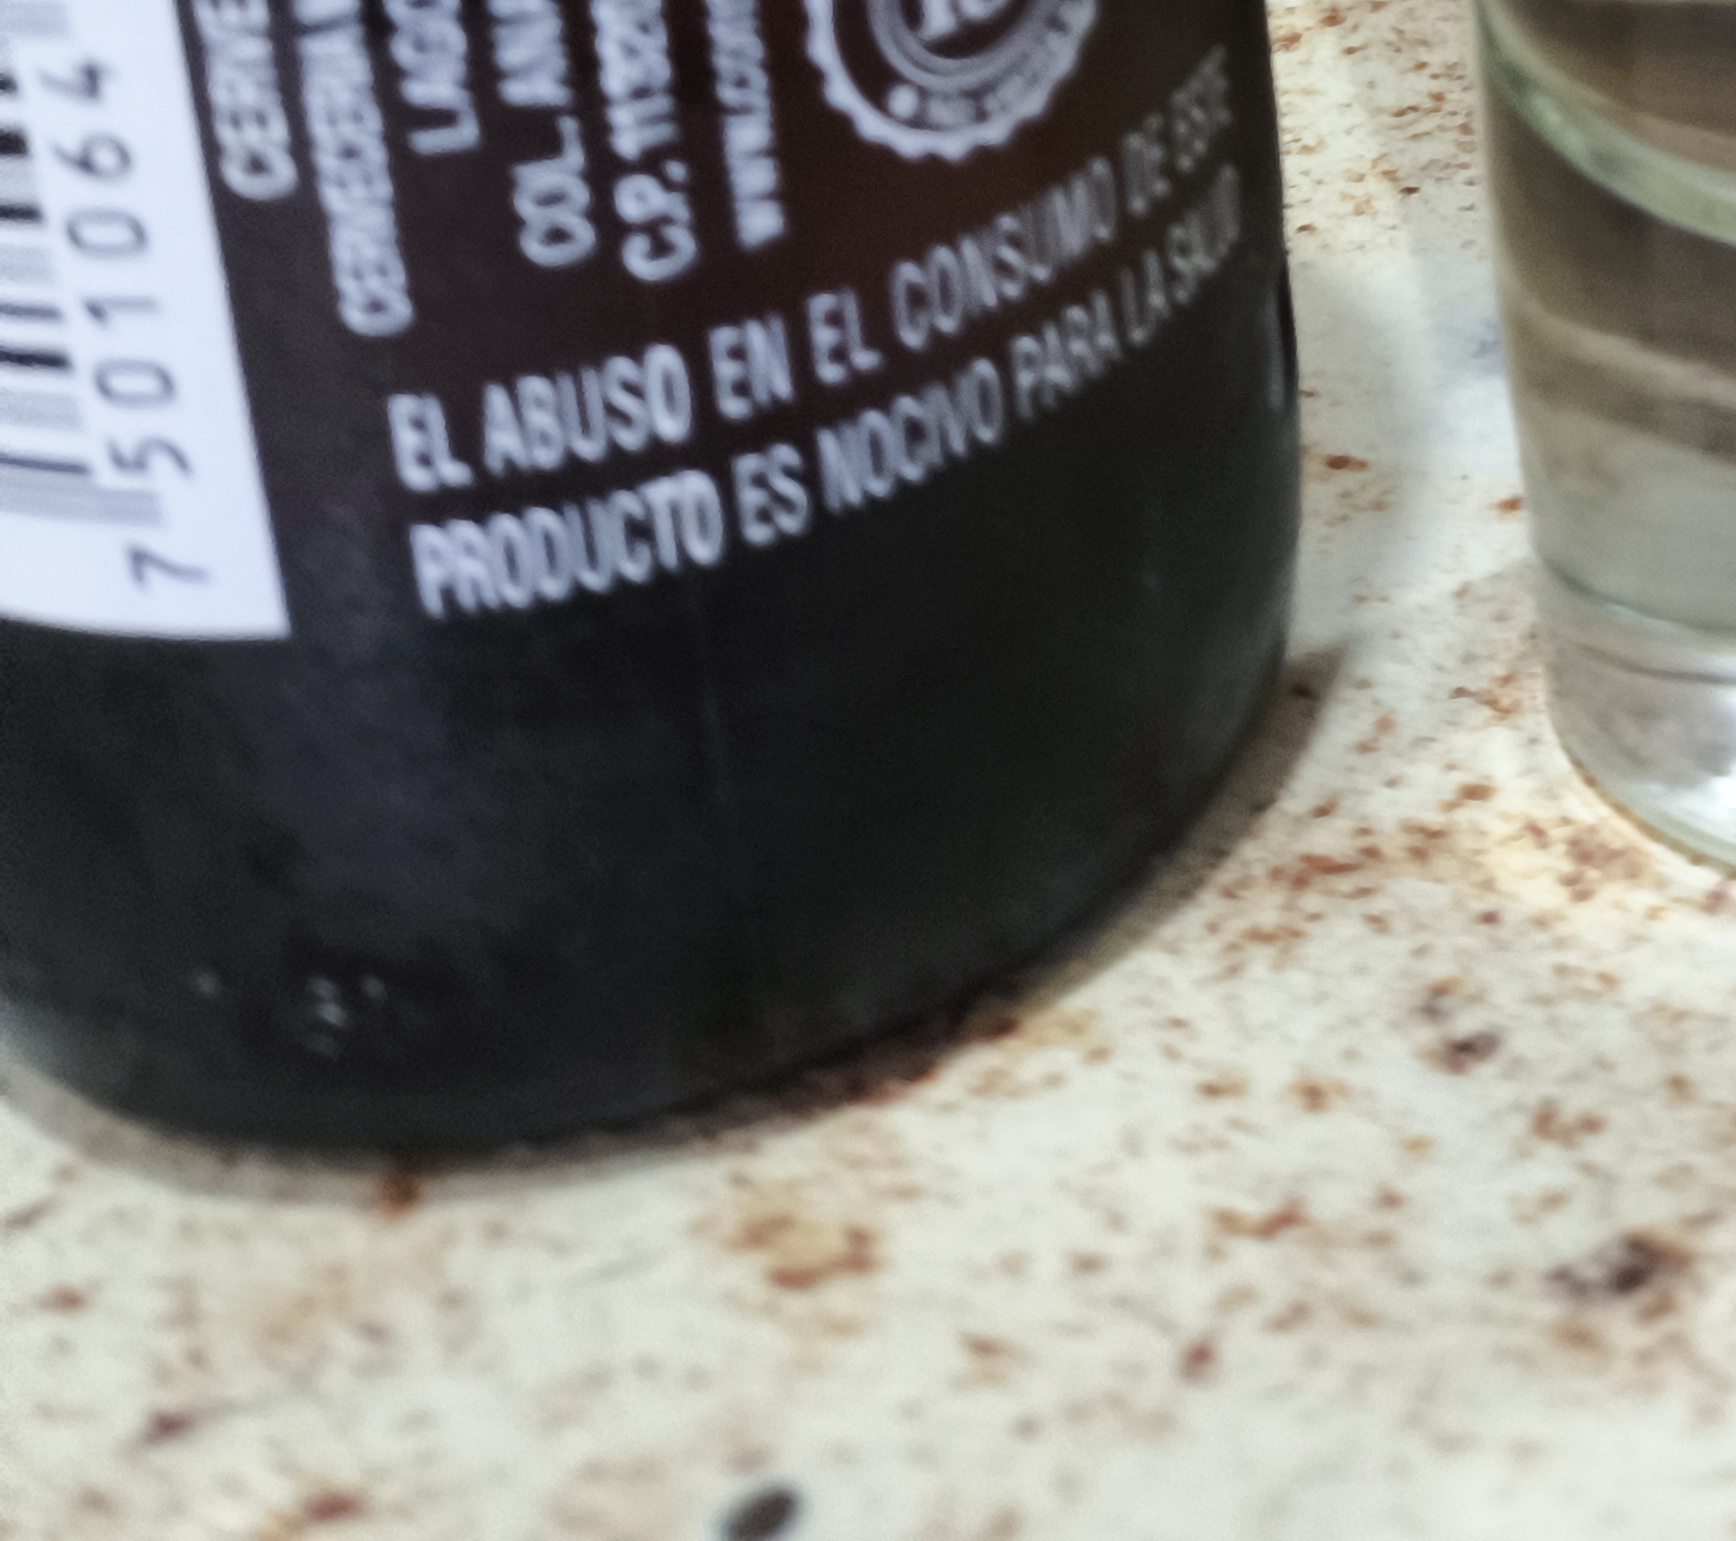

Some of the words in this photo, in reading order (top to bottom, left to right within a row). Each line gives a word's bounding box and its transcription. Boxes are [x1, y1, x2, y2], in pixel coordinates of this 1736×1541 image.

[38, 60, 192, 477] 501064
[386, 391, 474, 493] EL
[480, 341, 696, 477] ABUSO
[706, 311, 796, 423] EN
[804, 285, 886, 387] EL
[888, 153, 1118, 351] CONSUMO
[510, 113, 597, 267] COL.
[123, 539, 212, 593] 7
[408, 467, 728, 621] PRODUCTO
[730, 441, 812, 551] ES
[815, 355, 1006, 515] NOCIVO
